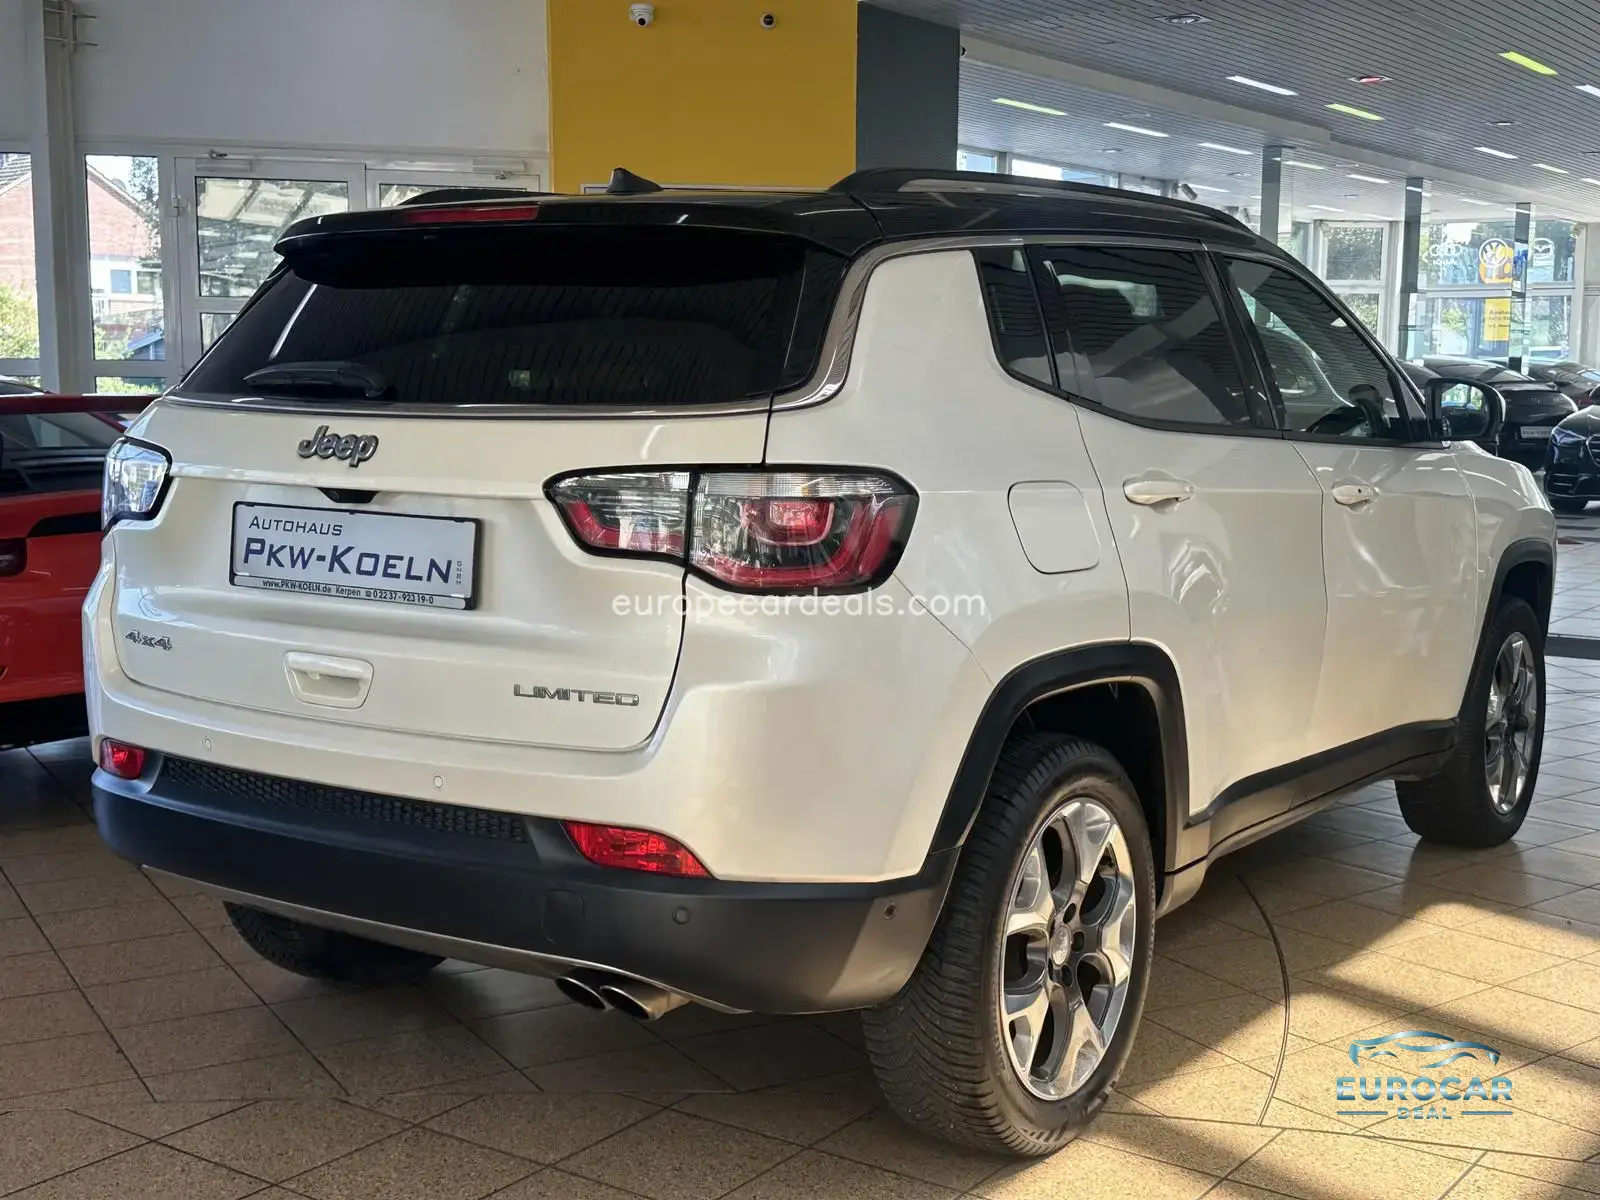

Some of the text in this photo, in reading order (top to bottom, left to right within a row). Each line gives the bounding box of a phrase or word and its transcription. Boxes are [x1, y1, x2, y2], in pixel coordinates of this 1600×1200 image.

[298, 425, 379, 468] Jeep
[248, 515, 343, 536] AUTOHAUS
[243, 537, 452, 584] PKW-KOELN
[262, 580, 332, 594] www.PKW-KOELN.de
[335, 586, 361, 597] Kerpen
[125, 629, 172, 651] 4x4
[513, 684, 640, 707] LIMITED
